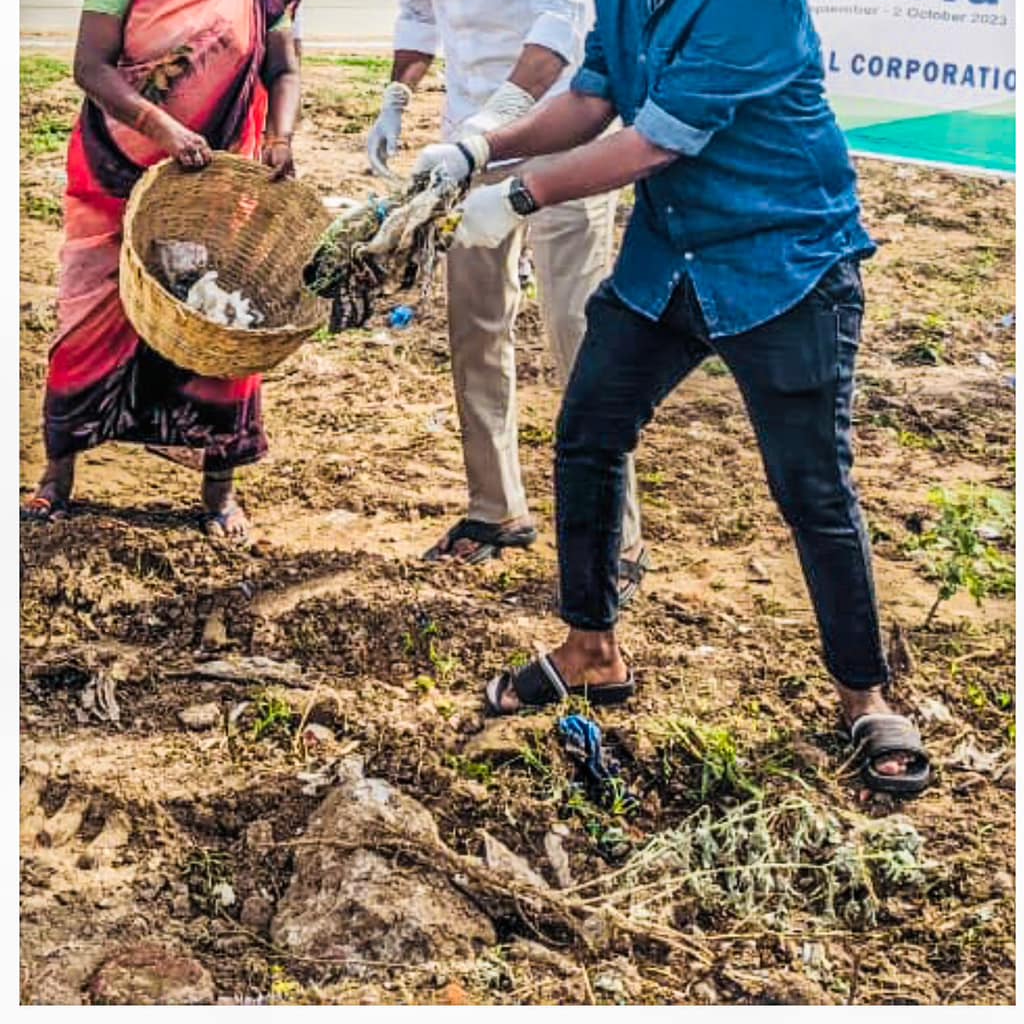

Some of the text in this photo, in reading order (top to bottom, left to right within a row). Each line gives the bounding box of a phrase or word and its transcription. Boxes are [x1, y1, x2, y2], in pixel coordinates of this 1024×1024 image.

[892, 7, 903, 18] 2
[906, 7, 967, 23] October
[970, 12, 1008, 27] 2023
